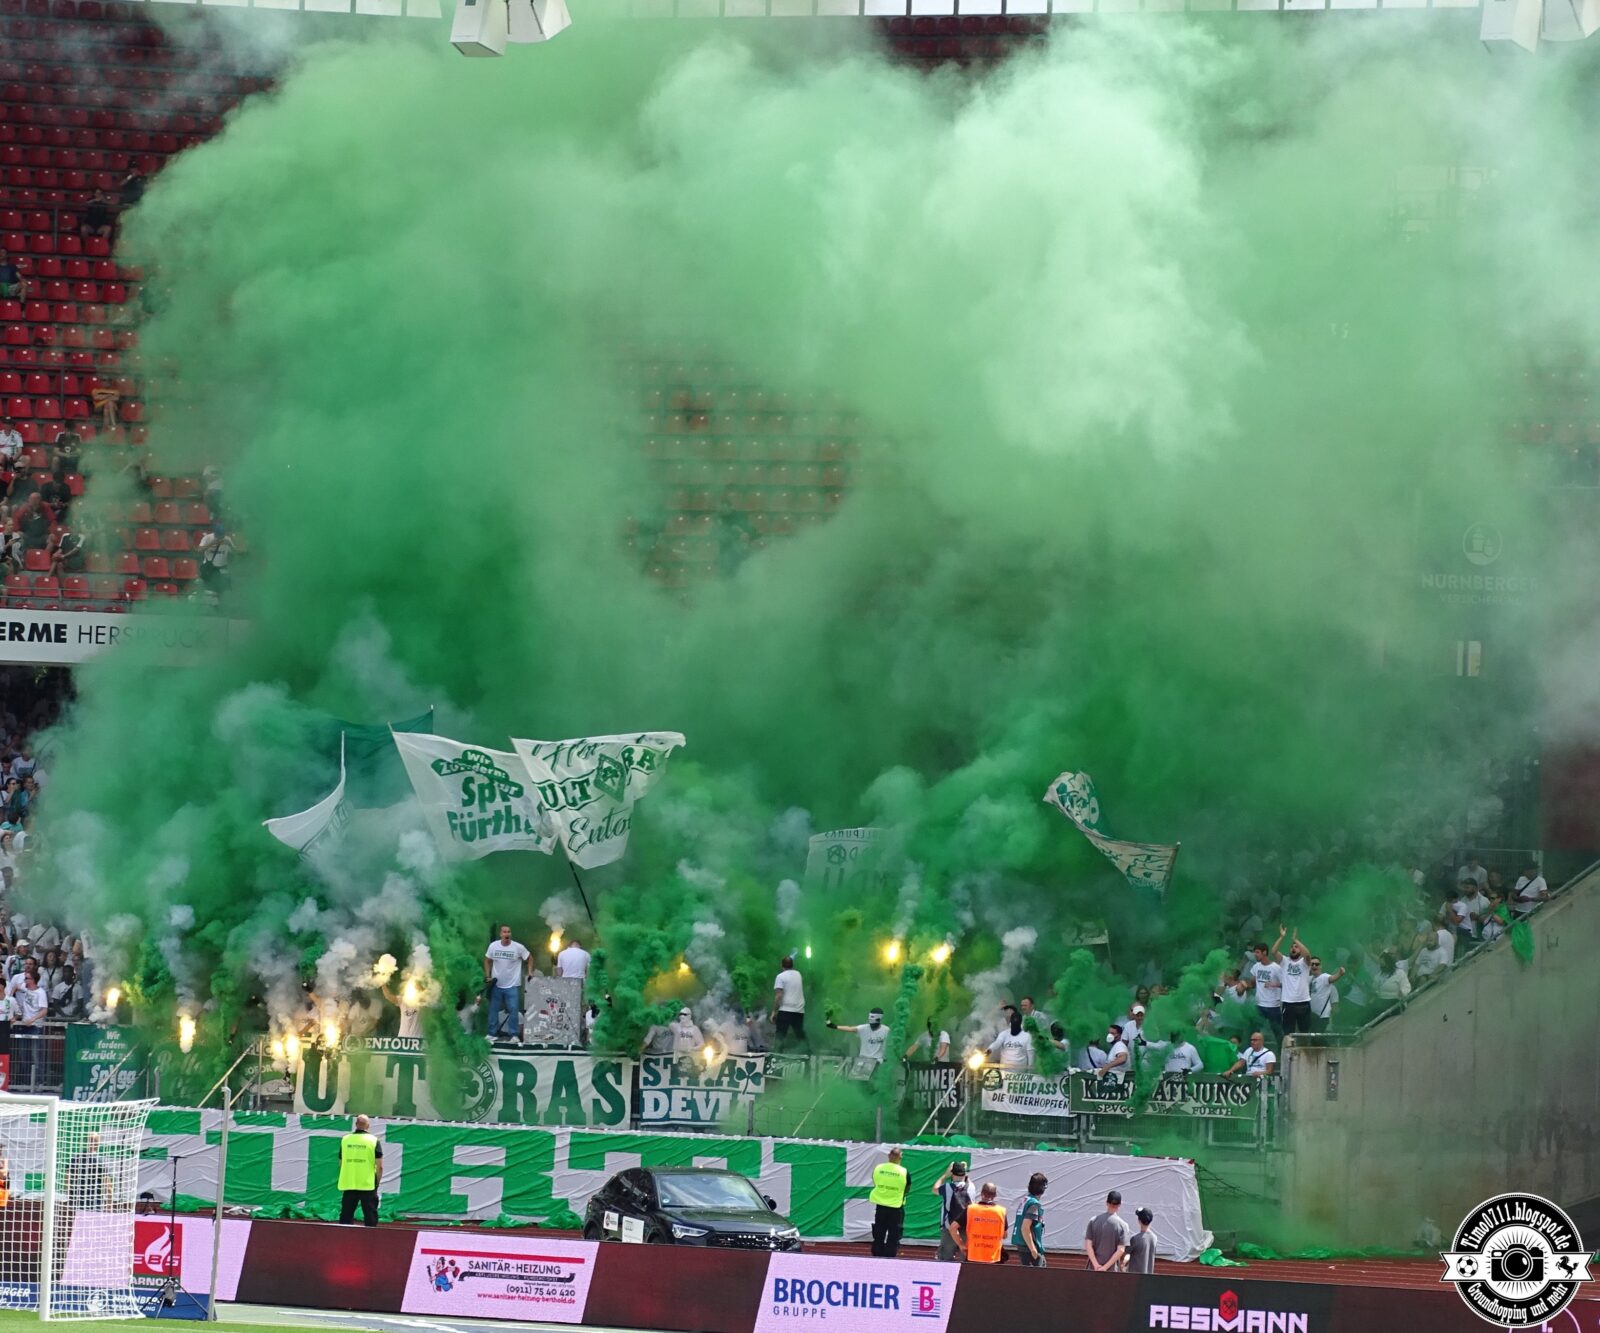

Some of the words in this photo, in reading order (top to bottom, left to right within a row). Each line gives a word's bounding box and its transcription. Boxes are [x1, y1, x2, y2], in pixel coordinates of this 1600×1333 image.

[467, 751, 491, 765] Wir
[447, 804, 523, 843] Fürth
[106, 1031, 120, 1040] Wir
[914, 1069, 956, 1090] IMMER
[1008, 1082, 1057, 1095] FEHLPASS
[992, 1093, 1006, 1102] DIE
[468, 1260, 562, 1275] SANITÄR-HEIZUNG
[506, 1283, 532, 1295] (0911)
[535, 1288, 544, 1296] 75
[546, 1289, 557, 1297] 40
[774, 1278, 900, 1310] BROCHIER
[773, 1305, 827, 1319] GRUPPE
[1149, 1304, 1308, 1333] ASSMANN
